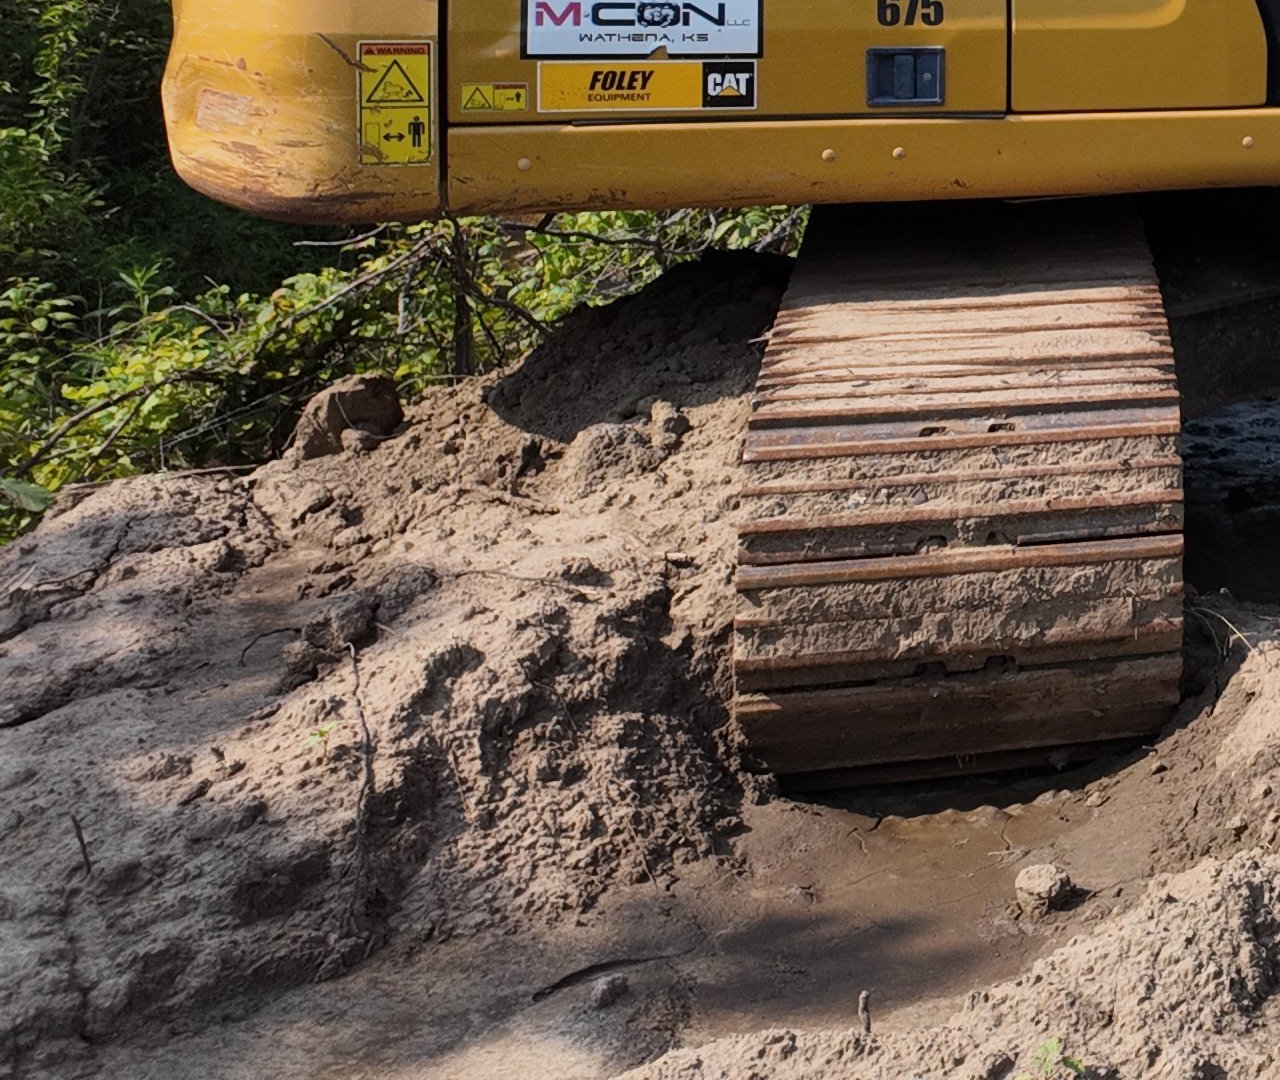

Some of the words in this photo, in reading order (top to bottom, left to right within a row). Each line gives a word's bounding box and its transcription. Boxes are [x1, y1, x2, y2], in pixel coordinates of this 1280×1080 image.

[682, 33, 709, 42] KS
[375, 47, 426, 55] WARNING
[588, 70, 655, 91] FOLEY
[707, 72, 751, 97] CAT
[587, 92, 653, 102] EQUIPMENT
